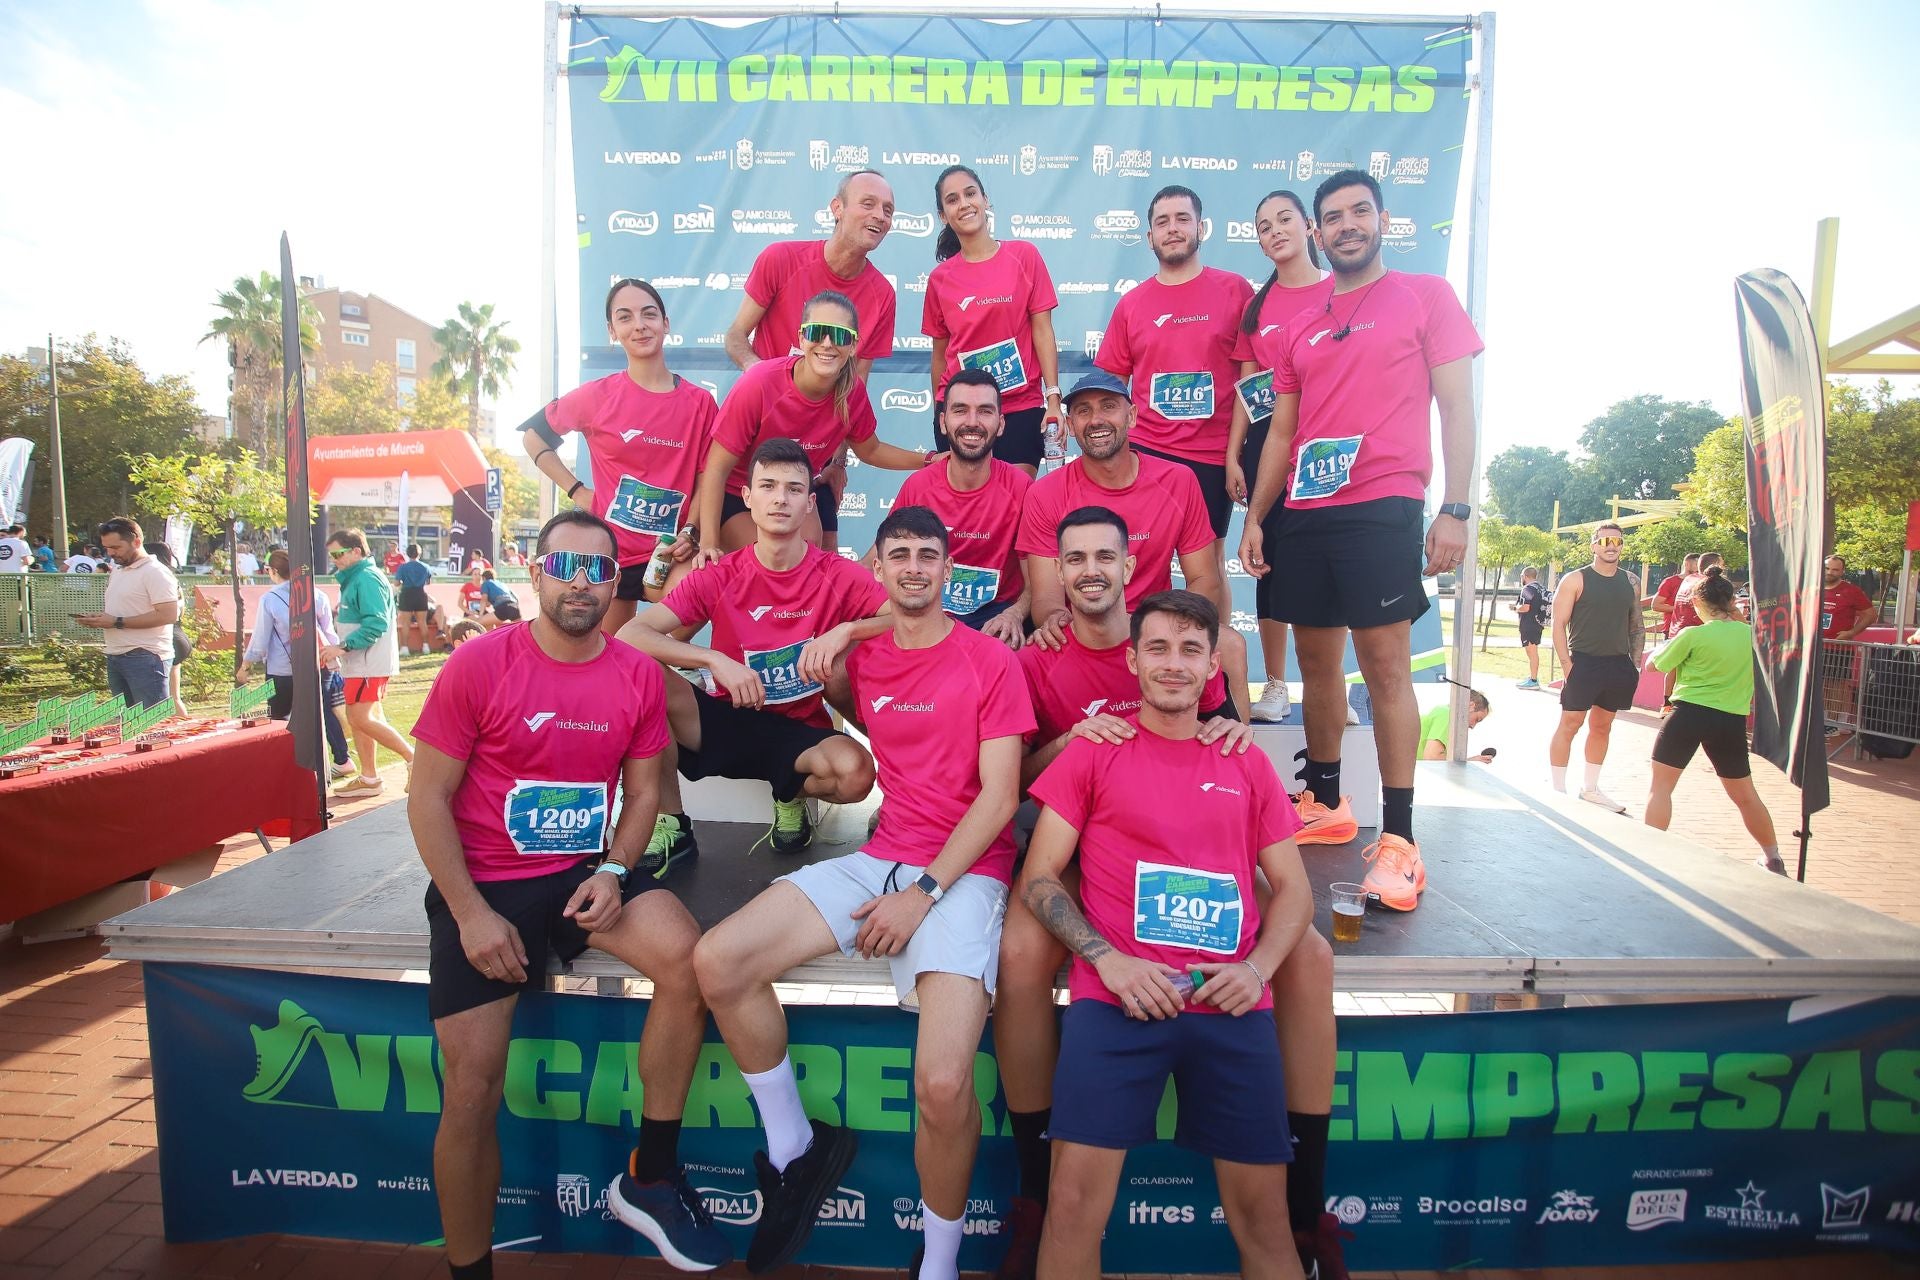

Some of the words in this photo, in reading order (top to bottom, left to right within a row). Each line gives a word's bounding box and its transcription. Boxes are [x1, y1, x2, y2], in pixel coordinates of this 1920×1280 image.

[728, 54, 1010, 106] CARRERA
[1021, 58, 1097, 106] DE
[1105, 59, 1438, 113] EMPRESAS
[604, 151, 623, 164] LA
[623, 152, 681, 165] VERDAD
[882, 152, 901, 164] LA
[902, 152, 960, 165] VERDAD
[1161, 156, 1181, 169] LA
[1181, 156, 1238, 171] VERDAD
[674, 211, 715, 229] DSM
[765, 210, 793, 220] GLOBAL
[1043, 215, 1072, 225] GLOBAL
[615, 217, 653, 229] VIDAL
[891, 219, 928, 231] VIDAL
[975, 294, 1013, 306] videsalud
[1172, 314, 1209, 324] videsalud
[982, 358, 1013, 377] 213
[889, 393, 925, 406] VIDAL
[1163, 386, 1204, 402] 1216
[642, 435, 684, 449] videsalud
[313, 445, 374, 461] Ayuntamiento
[376, 444, 388, 457] de
[390, 441, 425, 456] Murcia
[1306, 453, 1349, 479] 1219
[488, 471, 497, 494] P
[626, 494, 671, 517] 1210
[953, 526, 991, 540] videsalud
[1128, 531, 1150, 541] salud
[944, 581, 984, 600] 1211
[762, 663, 796, 684] 121
[892, 702, 934, 712] videsalud
[1108, 698, 1143, 712] videsa
[555, 718, 609, 733] videsalud
[8, 754, 40, 766] VERDAD
[1214, 785, 1241, 796] videsalud
[526, 807, 591, 829] 1209
[1153, 893, 1224, 924] 1207
[1170, 922, 1201, 932] VIDESALUD
[318, 1032, 445, 1113] VI
[503, 1038, 1012, 1137] CARRE
[685, 1163, 745, 1175] PATROCINAN
[232, 1168, 265, 1187] LA
[265, 1169, 358, 1189] VERDAD
[377, 1179, 431, 1192] MURCIA
[1130, 1176, 1194, 1185] COLABORAN
[499, 1186, 540, 1196] tamiento
[702, 1198, 753, 1214] VIDAL
[1417, 1195, 1527, 1214] Brocalsa
[1636, 1193, 1682, 1205] AQUA
[818, 1198, 866, 1220] SM
[966, 1199, 997, 1214] OBAL
[1129, 1200, 1195, 1225] itres
[1635, 1204, 1678, 1216] DEUS
[1705, 1205, 1800, 1225] ESTRELLA
[1727, 1219, 1738, 1227] DE
[1740, 1220, 1780, 1230] LEVANTE
